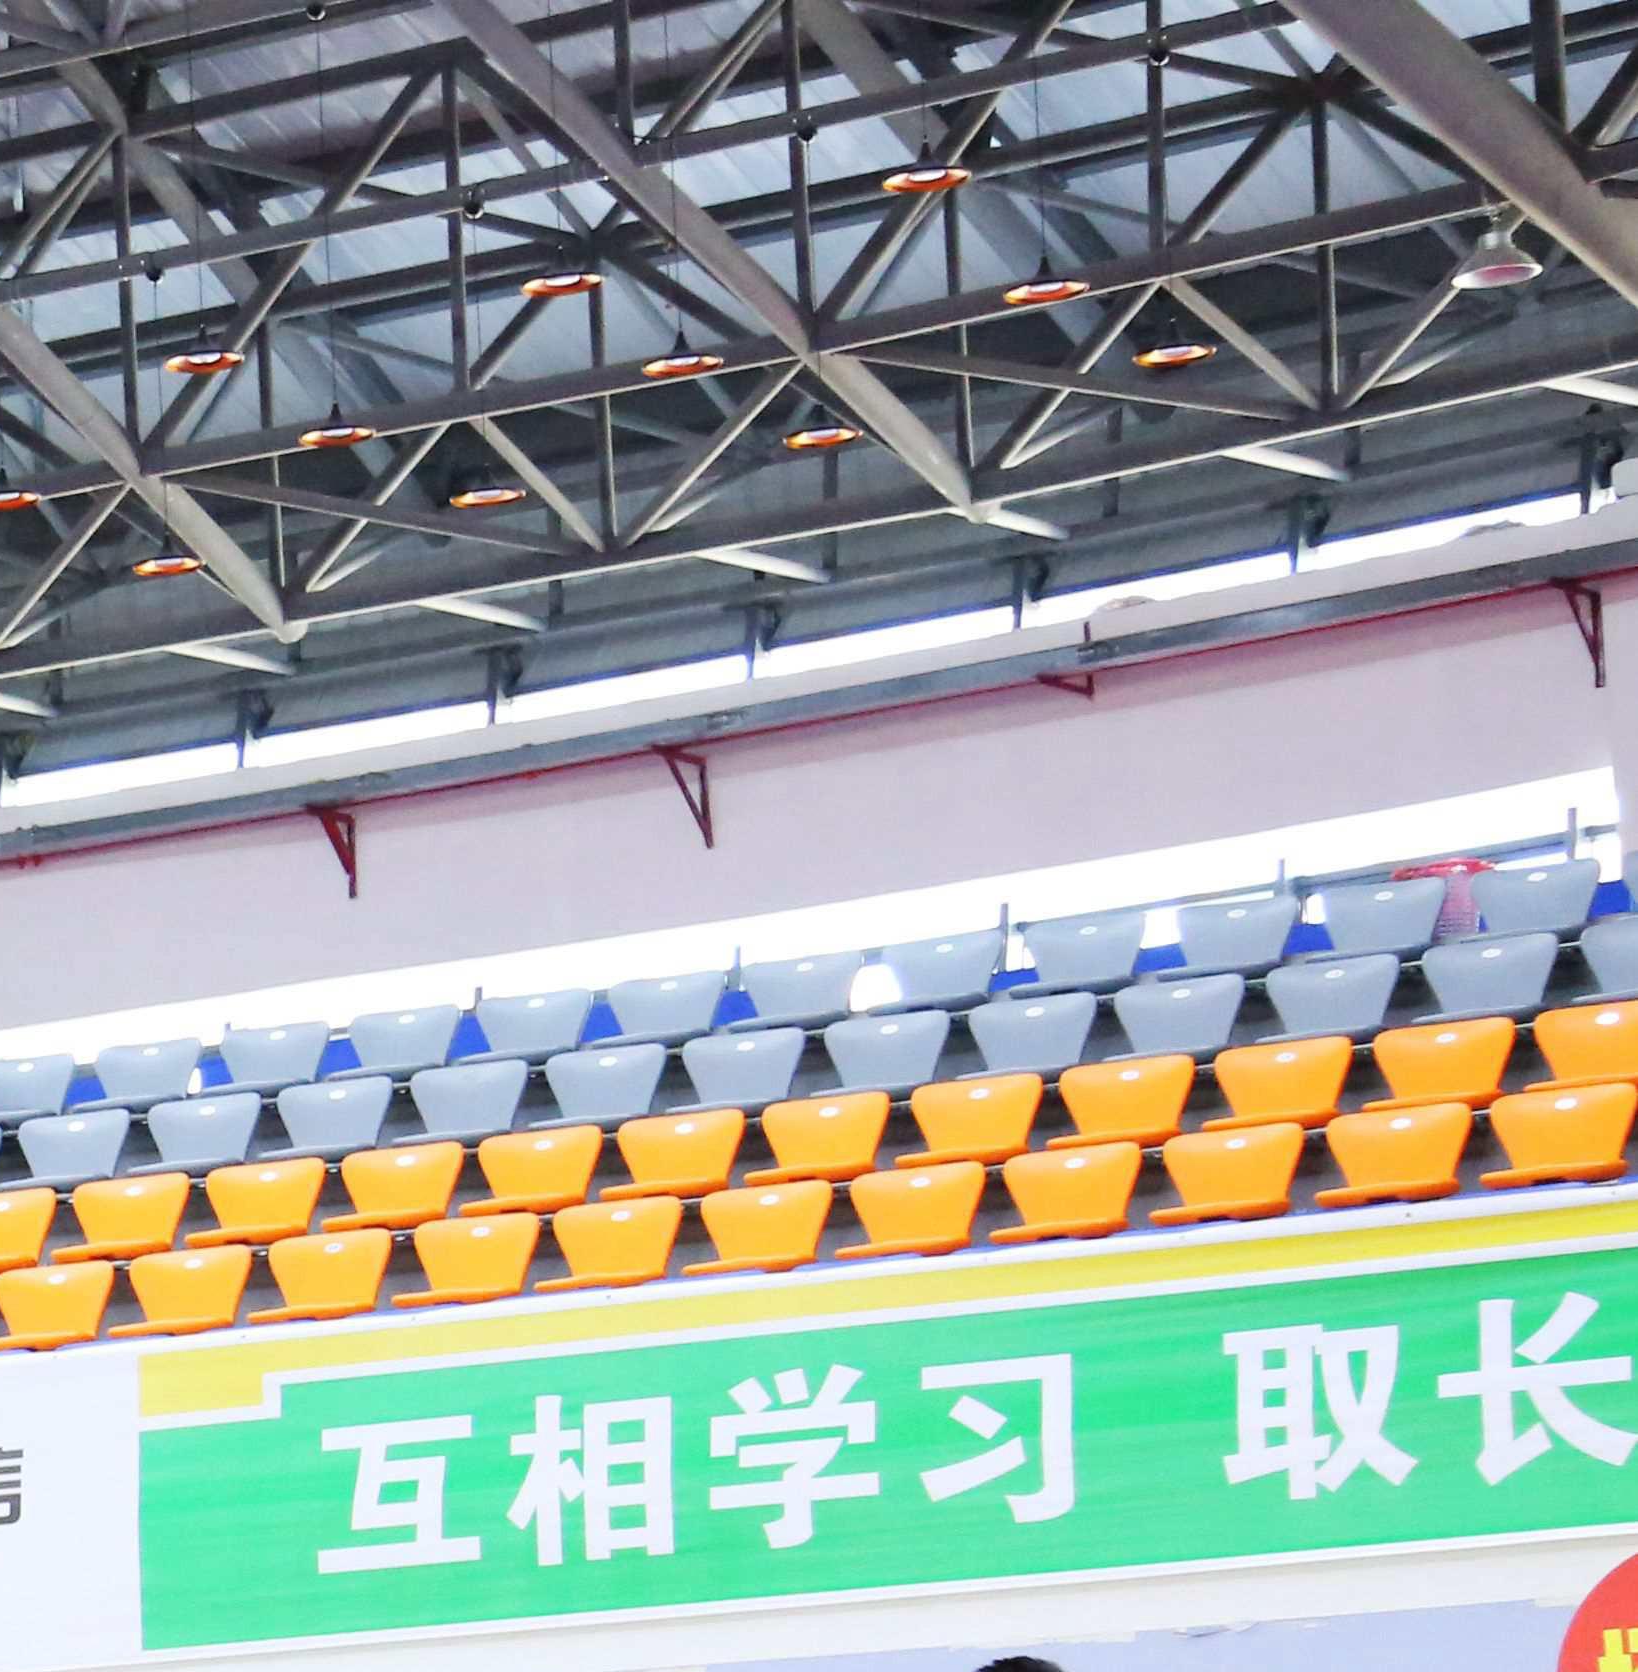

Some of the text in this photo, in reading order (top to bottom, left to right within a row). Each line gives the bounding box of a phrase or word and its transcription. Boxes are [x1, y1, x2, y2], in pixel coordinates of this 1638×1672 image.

[317, 1291, 1638, 1574] 互相学习 取长
